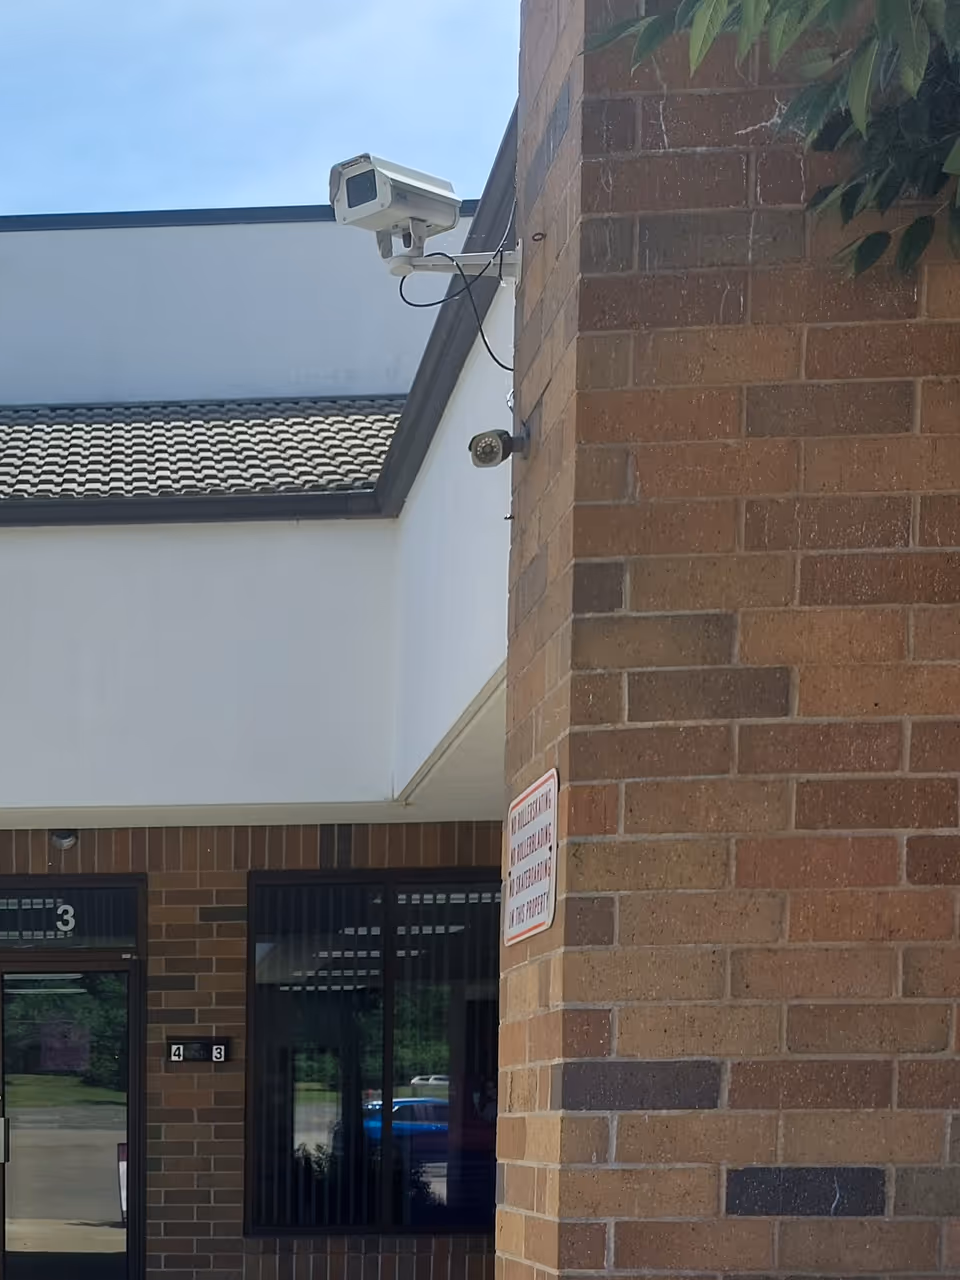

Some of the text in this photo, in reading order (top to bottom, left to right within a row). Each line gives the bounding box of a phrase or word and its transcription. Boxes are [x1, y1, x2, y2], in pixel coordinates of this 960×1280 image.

[55, 904, 76, 932] 3
[173, 1046, 182, 1059] 4
[214, 1047, 223, 1060] 3
